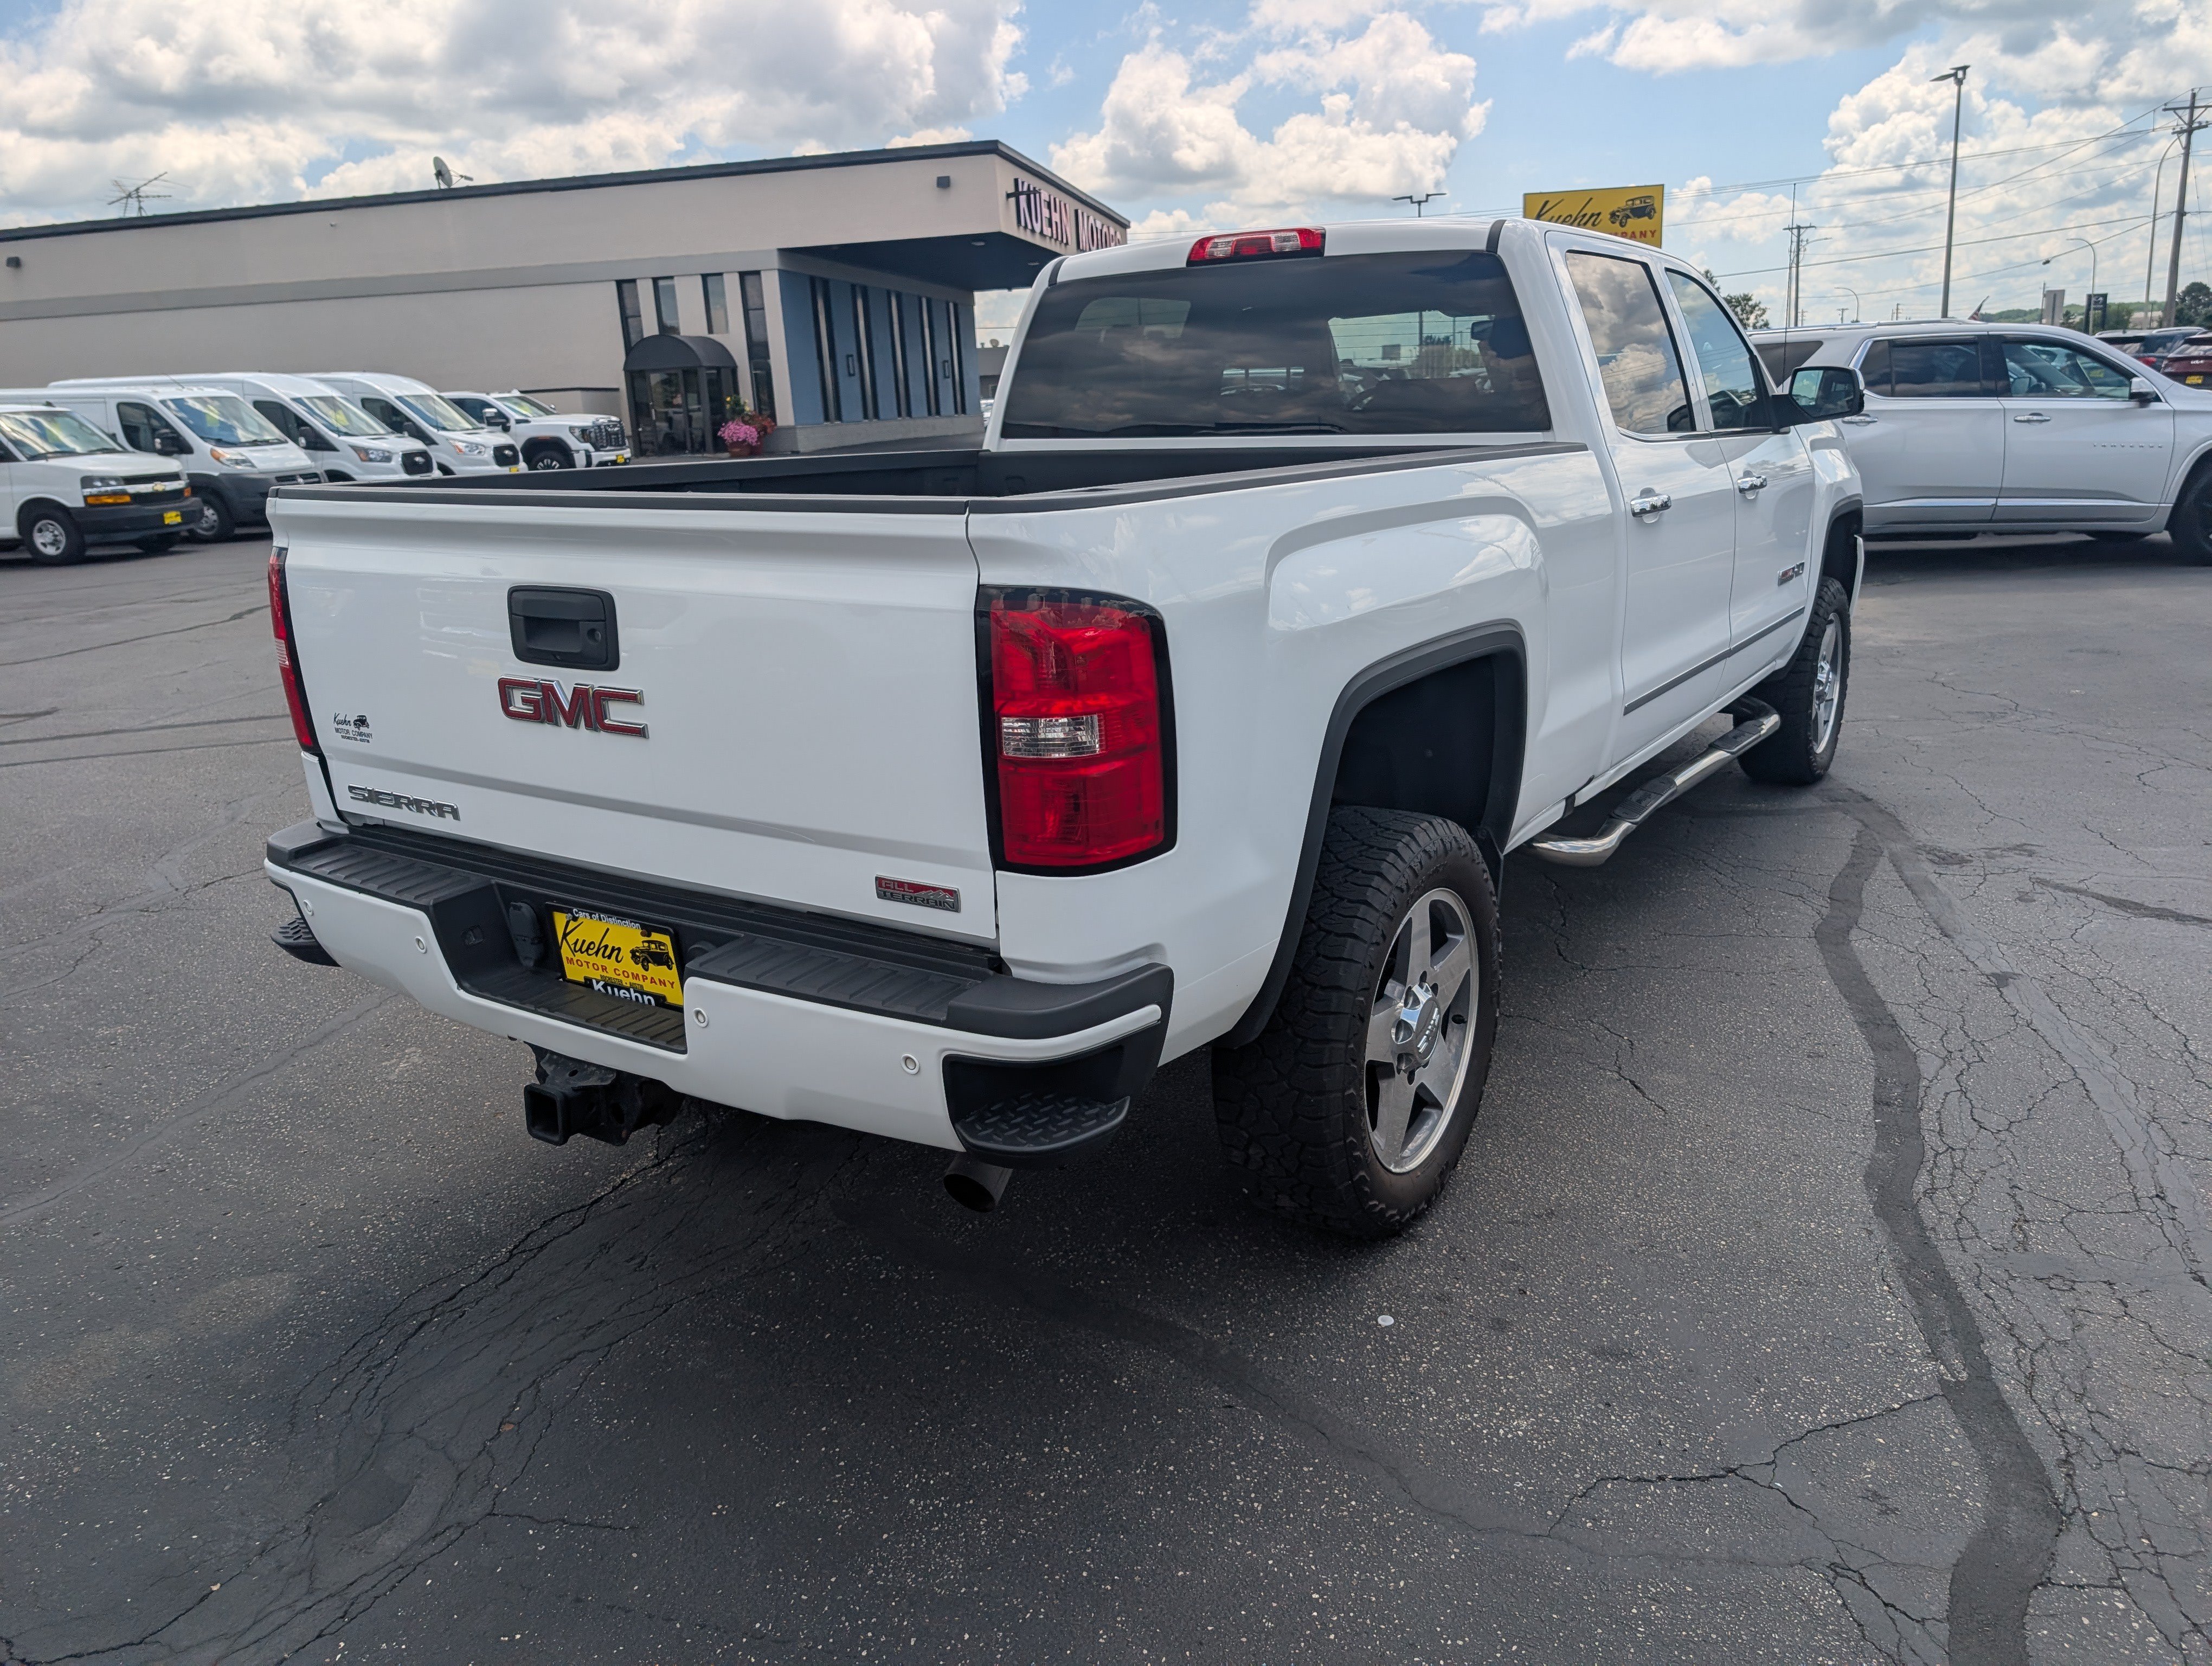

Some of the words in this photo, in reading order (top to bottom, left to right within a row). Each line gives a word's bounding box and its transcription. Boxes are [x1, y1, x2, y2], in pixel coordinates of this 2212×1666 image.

[1014, 178, 1072, 246] KUEHN
[1535, 197, 1602, 227] Kuehn
[333, 712, 351, 726] Kuehn
[498, 674, 650, 739] GMC
[334, 727, 350, 735] MOTOR
[351, 729, 373, 739] COMPANY
[348, 783, 461, 821] SIERRA
[878, 890, 955, 910] TERRAIN
[882, 880, 914, 892] ALL
[573, 908, 590, 919] Cars
[591, 913, 600, 921] of
[600, 913, 642, 930] Distinction
[560, 920, 624, 964] Kuehn
[565, 956, 609, 974] MOTOR
[613, 967, 675, 989] COMPANY
[592, 978, 655, 1007] Kuehn
